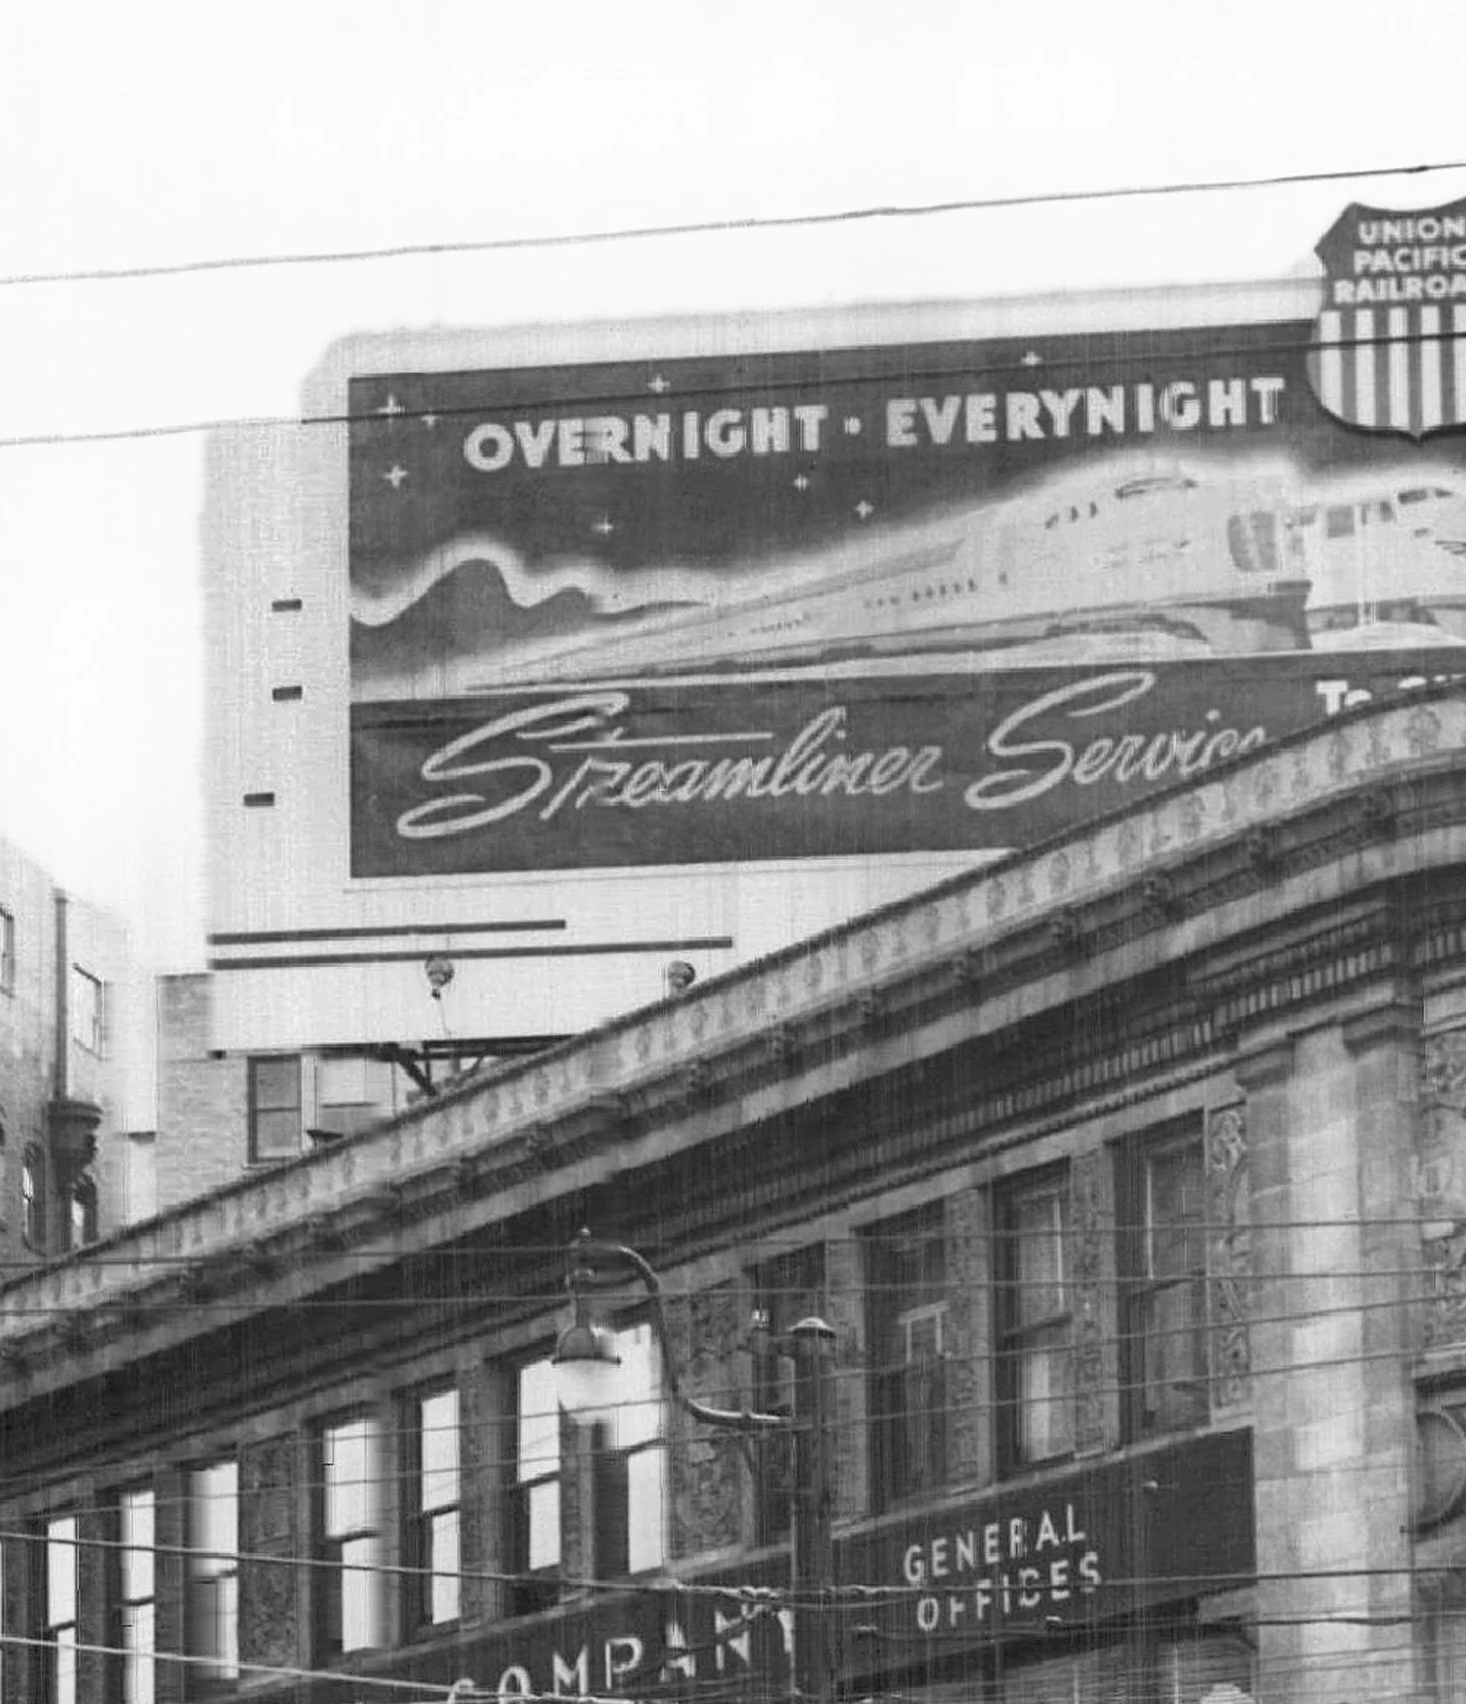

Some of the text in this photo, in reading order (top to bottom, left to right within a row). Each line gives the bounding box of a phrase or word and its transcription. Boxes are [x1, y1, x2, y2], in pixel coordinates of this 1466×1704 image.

[1357, 215, 1466, 245] UNION
[463, 375, 1286, 472] OVERNIGHT EVERYNIGHT
[396, 691, 944, 839] Streamliner
[903, 1503, 1087, 1584] GENERAL
[917, 1550, 1102, 1632] OFFICES
